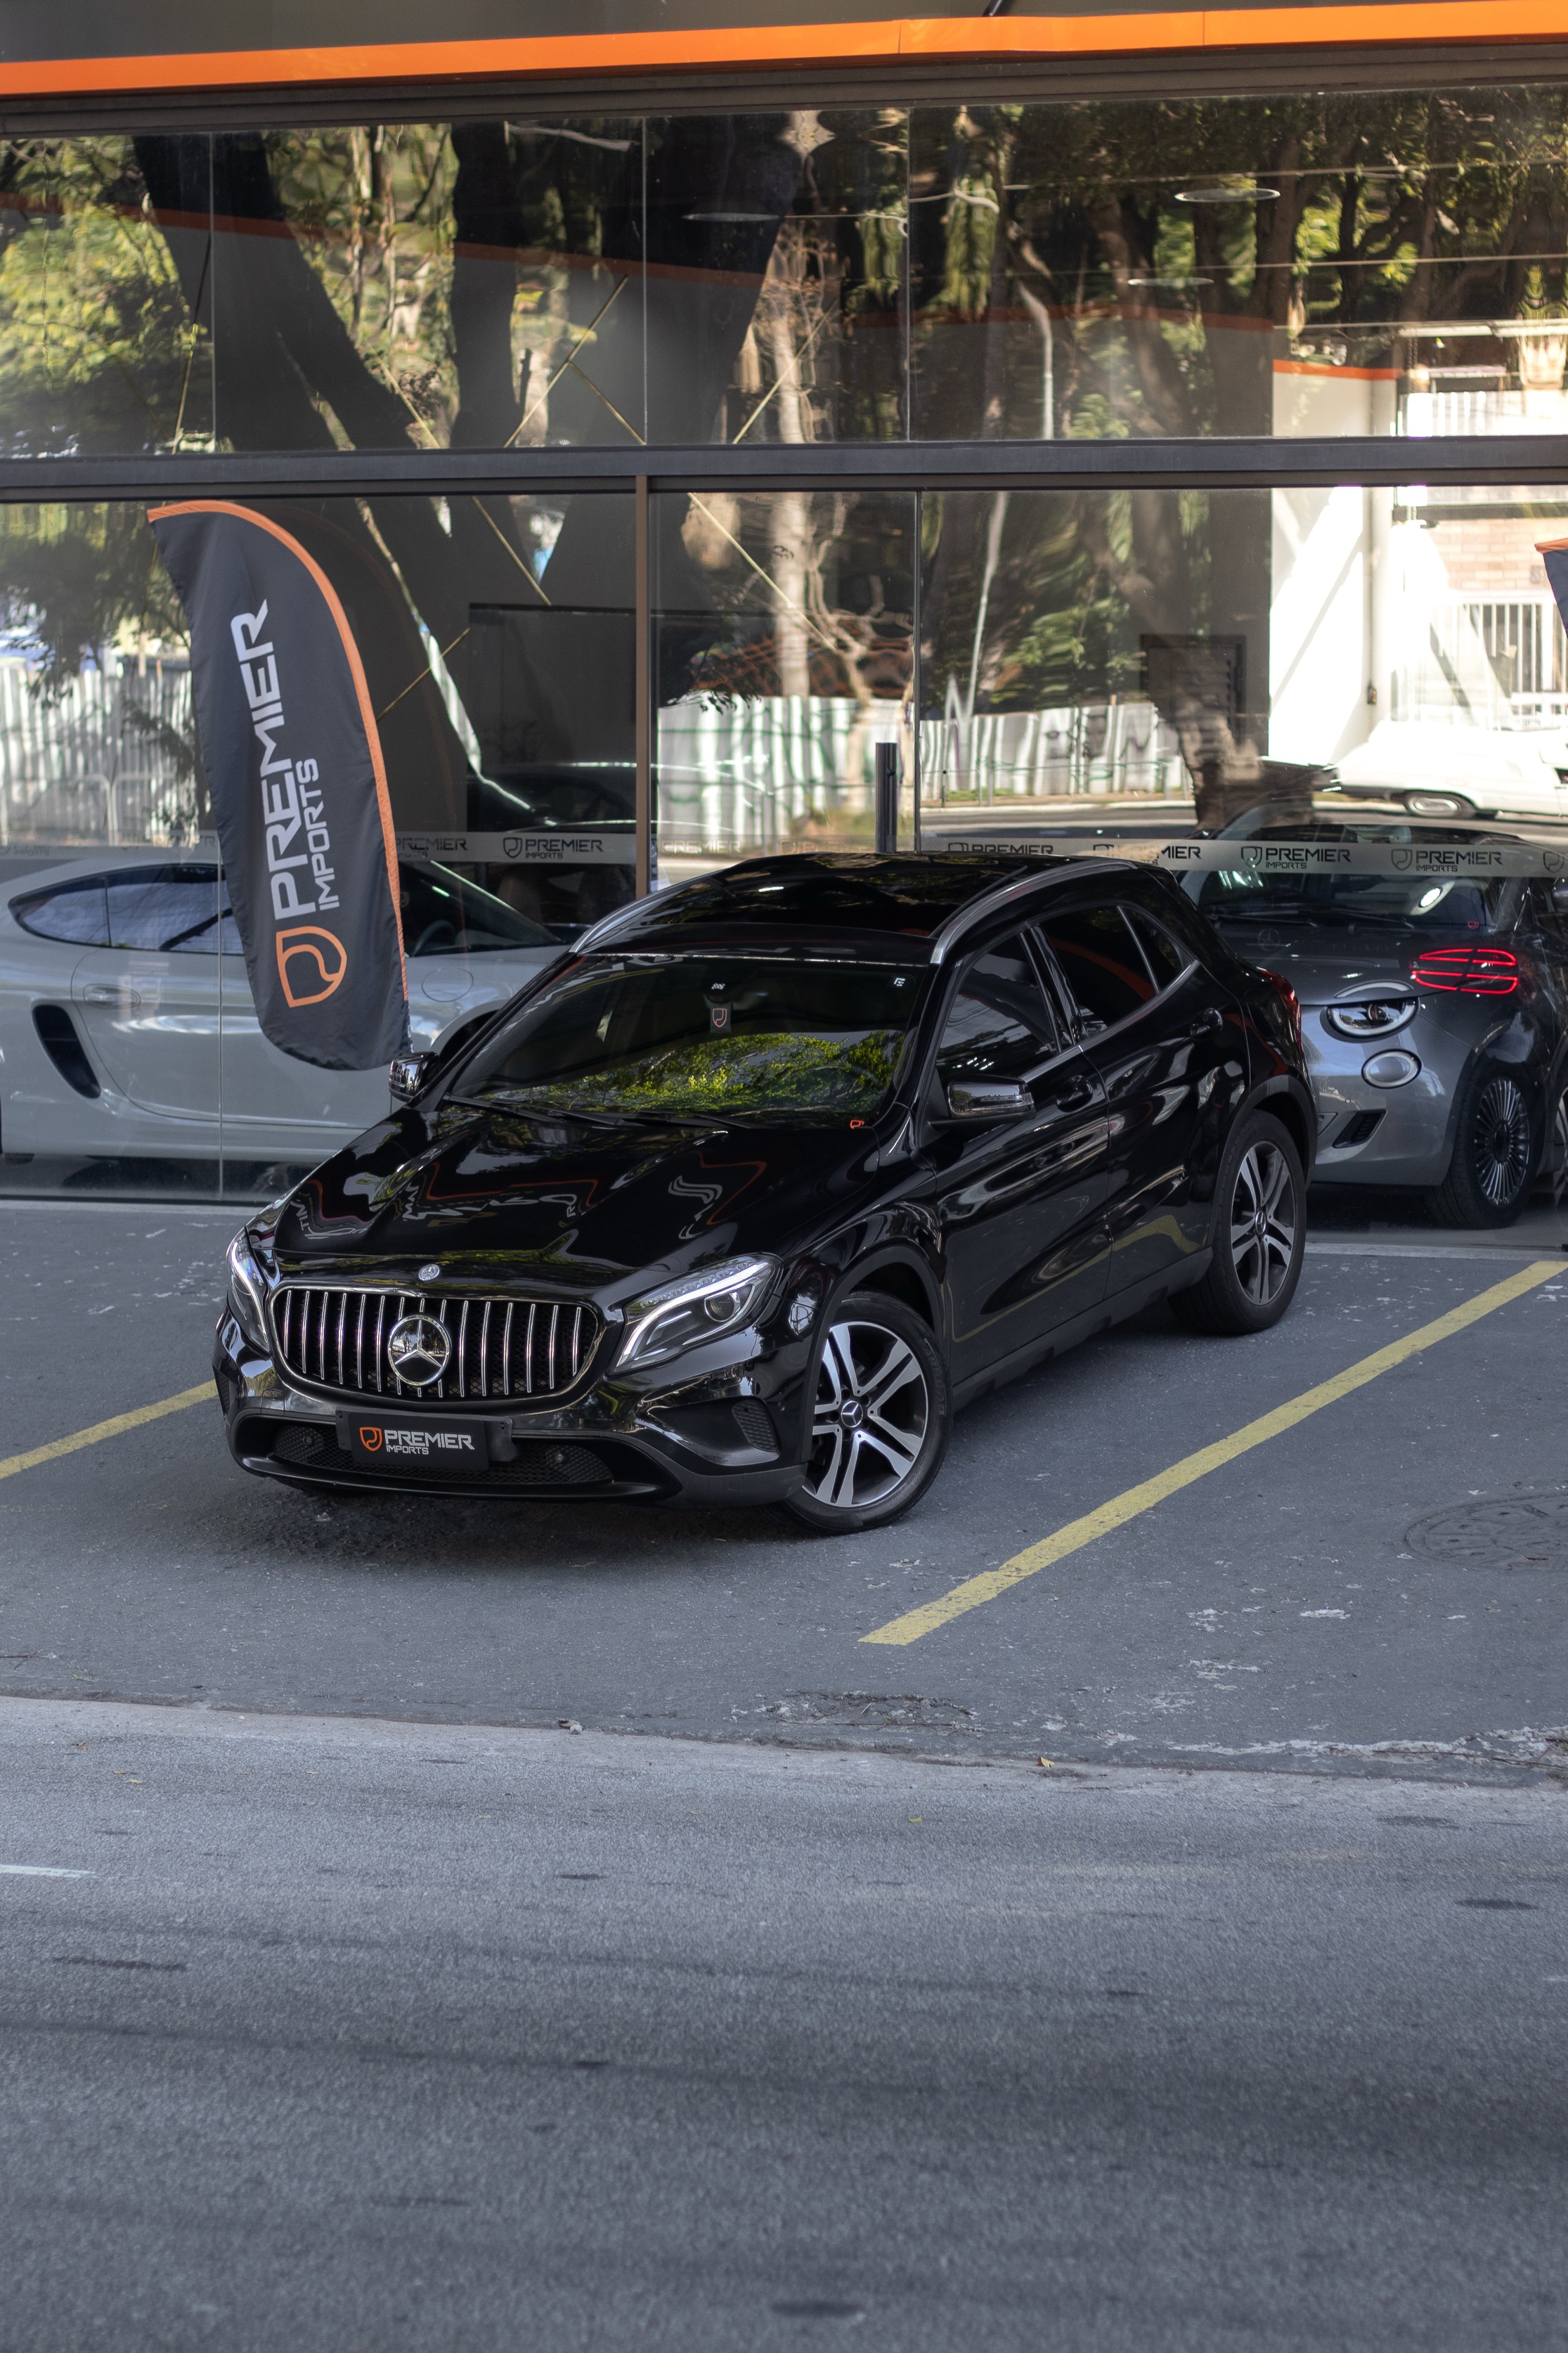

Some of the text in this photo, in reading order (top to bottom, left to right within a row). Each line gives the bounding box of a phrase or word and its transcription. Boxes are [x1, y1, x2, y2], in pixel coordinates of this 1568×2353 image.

[231, 599, 316, 920] PREMIER
[295, 758, 339, 910] IMPORTS
[525, 839, 604, 852] PREMIER
[1157, 846, 1202, 859] MIER
[1265, 847, 1352, 863] PREMIER
[1415, 851, 1503, 865] PREMIER
[1415, 864, 1458, 872] IMPORTS
[384, 1429, 475, 1450] PREMIER
[386, 1444, 429, 1455] IMPORTS
